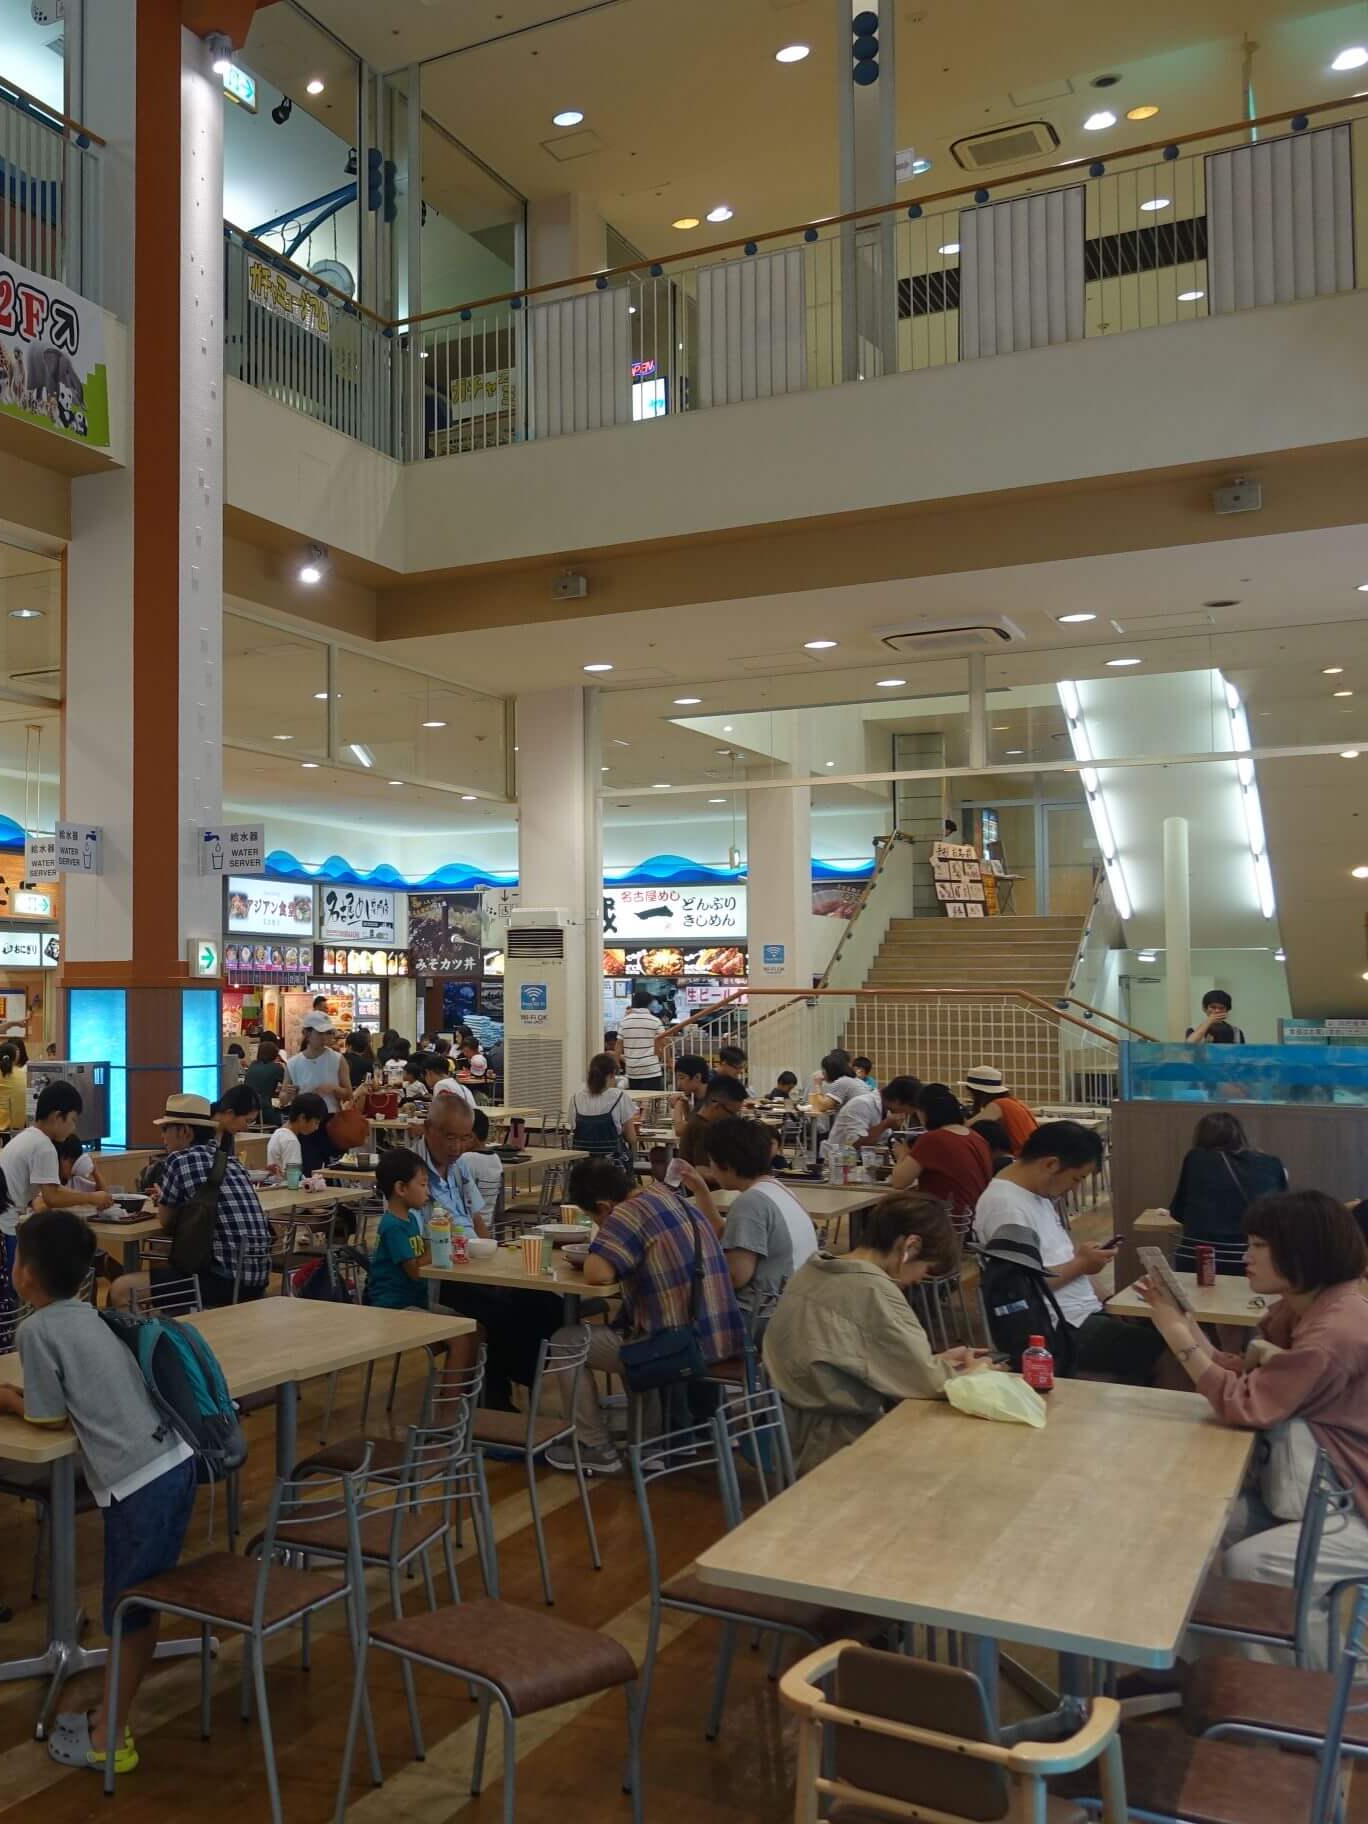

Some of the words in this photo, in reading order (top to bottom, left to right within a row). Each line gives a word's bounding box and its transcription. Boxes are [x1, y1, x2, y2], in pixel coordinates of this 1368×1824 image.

[59, 829, 79, 841] 給水器
[230, 831, 258, 842] 給水器
[60, 847, 79, 855] WATER
[231, 848, 259, 857] WATER
[31, 859, 55, 867] WATER
[58, 857, 81, 866] SERVER
[229, 858, 261, 868] SERVER
[30, 869, 57, 877] SERVER
[620, 890, 681, 903] 名古屋めし
[682, 896, 737, 911] どんぶり
[683, 914, 736, 927] きしめん
[415, 956, 477, 971] みそカツ丼
